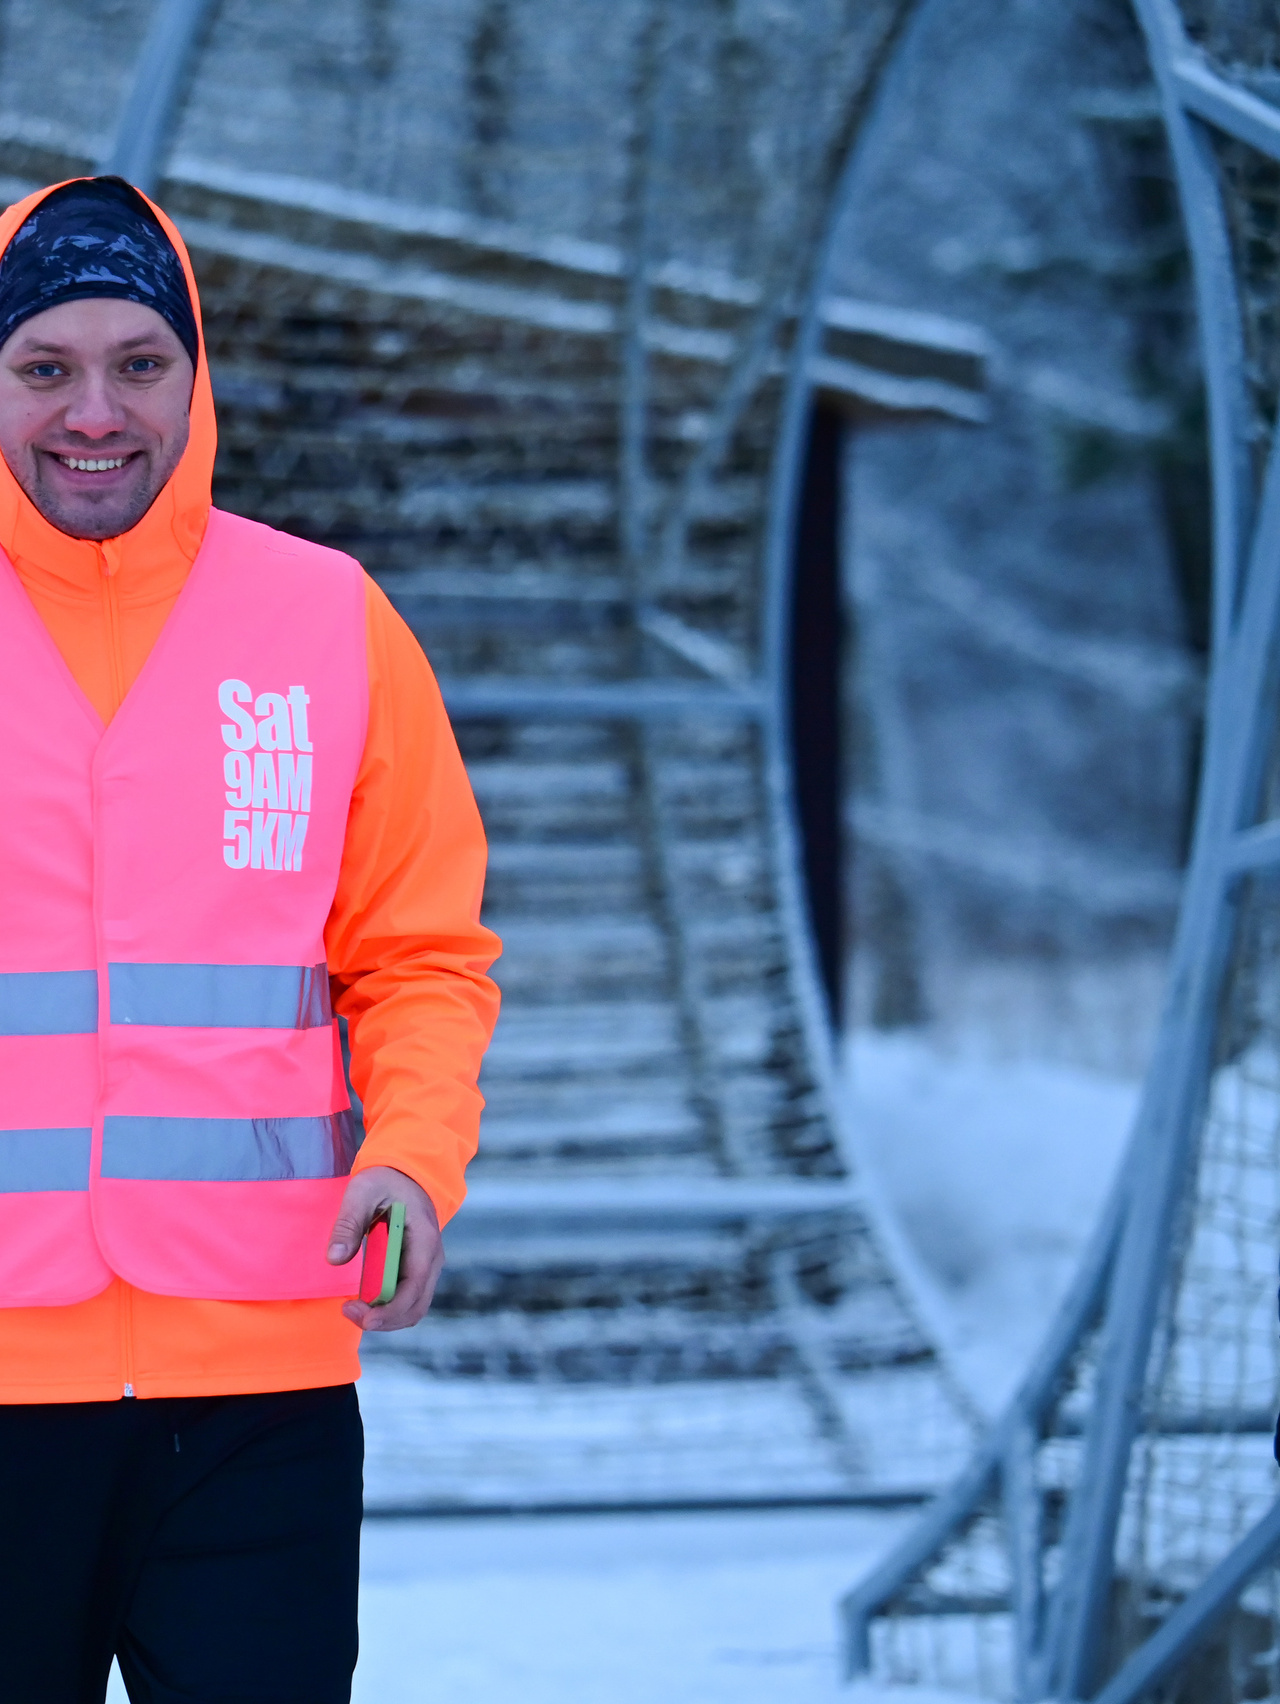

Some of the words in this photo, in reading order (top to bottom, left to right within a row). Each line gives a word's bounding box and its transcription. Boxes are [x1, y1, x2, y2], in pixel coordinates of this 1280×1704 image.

[218, 679, 313, 752] Sat
[223, 751, 313, 812] 9AM
[223, 810, 309, 871] 5KM
